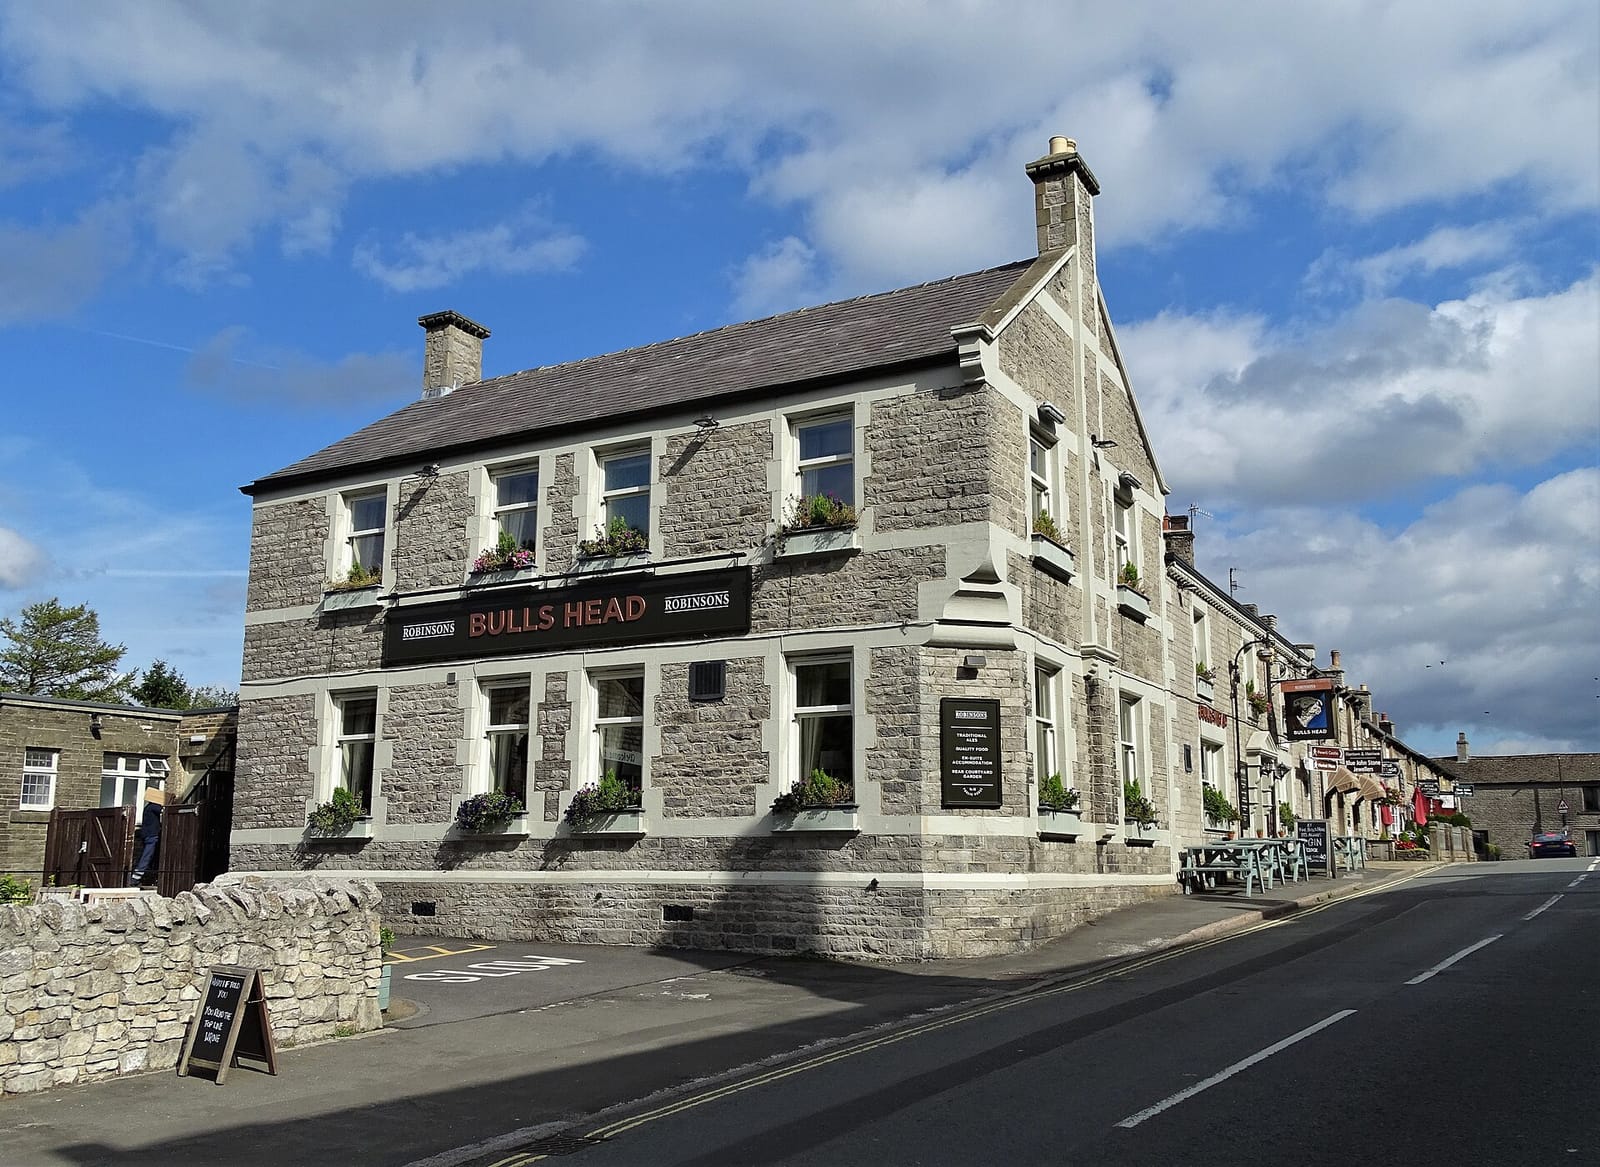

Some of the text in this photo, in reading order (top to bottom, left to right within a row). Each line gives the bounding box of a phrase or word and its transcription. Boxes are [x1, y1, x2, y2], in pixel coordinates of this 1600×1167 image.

[664, 593, 730, 611] ROBINSONS
[468, 595, 646, 638] BULLS HEAD
[402, 622, 455, 638] ROBINSONS
[1307, 837, 1322, 847] GIN
[403, 955, 586, 983] SLOW
